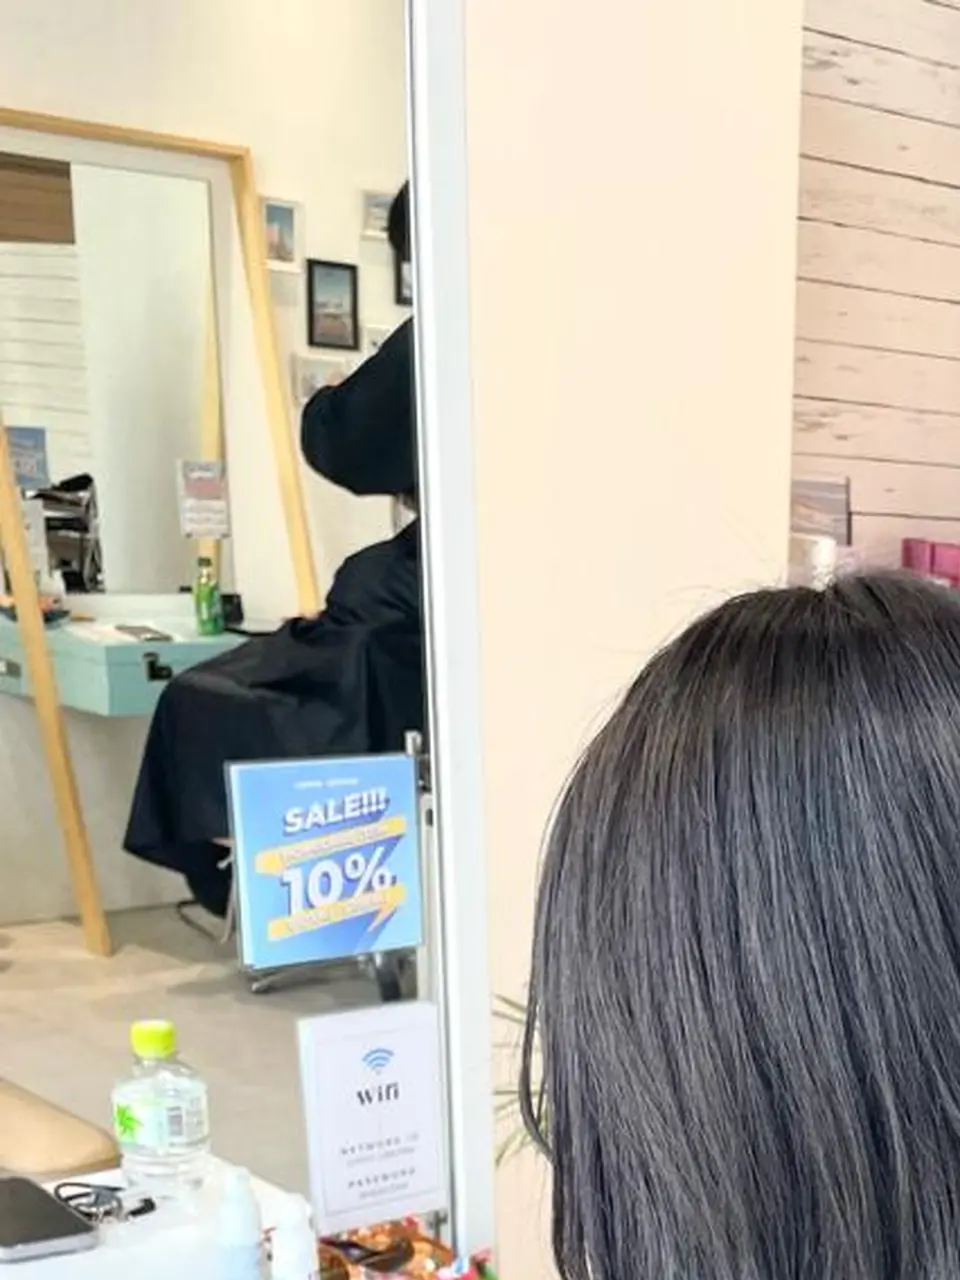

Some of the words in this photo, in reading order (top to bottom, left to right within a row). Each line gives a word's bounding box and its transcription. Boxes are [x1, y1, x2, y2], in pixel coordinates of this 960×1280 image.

[284, 787, 388, 833] SALE!!!
[281, 847, 394, 917] 10%
[356, 1082, 399, 1106] Wifi
